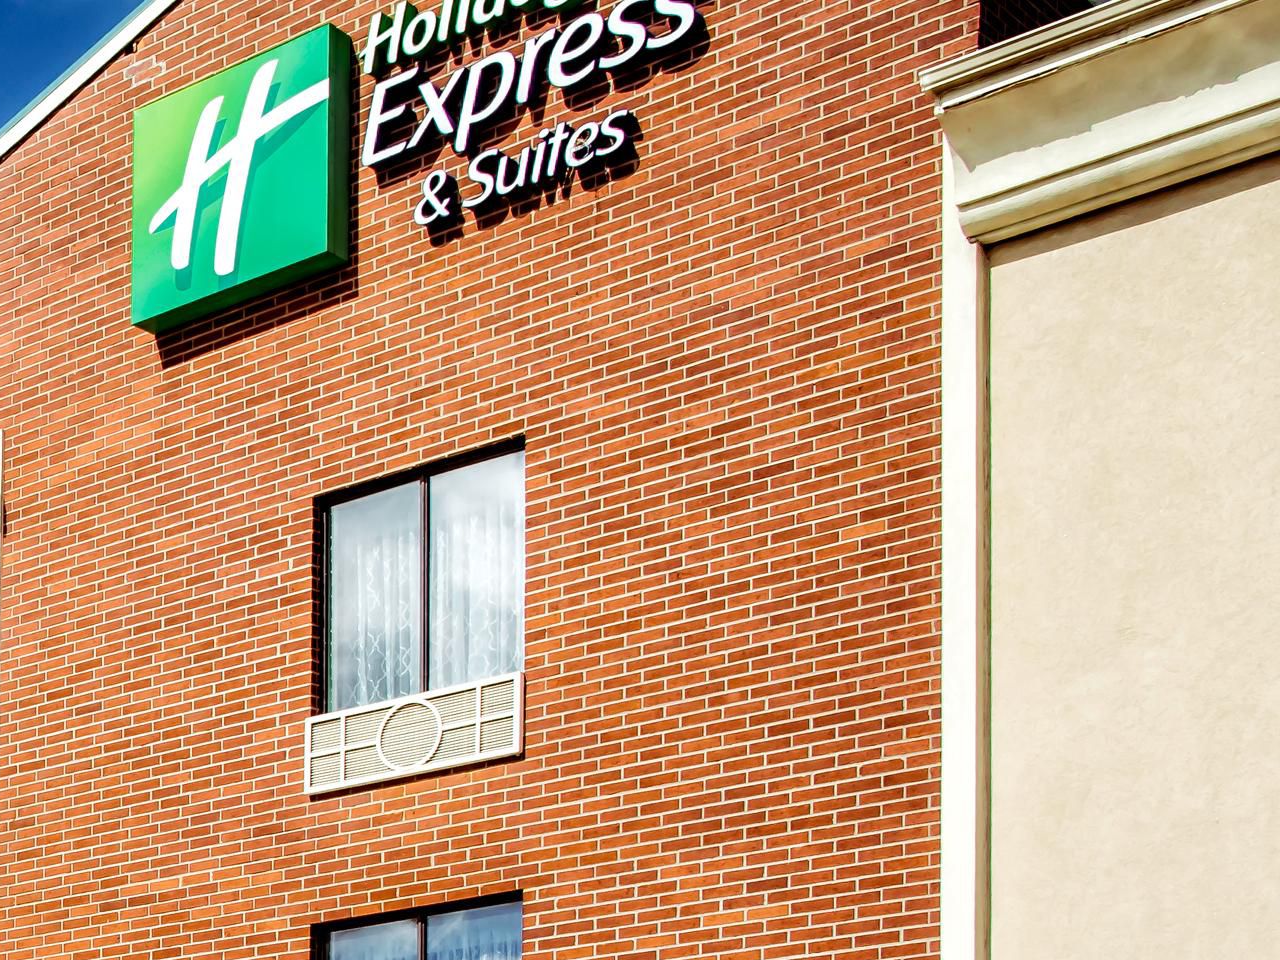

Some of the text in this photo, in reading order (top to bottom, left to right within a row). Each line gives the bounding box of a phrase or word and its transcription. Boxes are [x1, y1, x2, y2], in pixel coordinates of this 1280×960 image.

[361, 0, 696, 167] Express
[414, 109, 629, 226] & Suites
